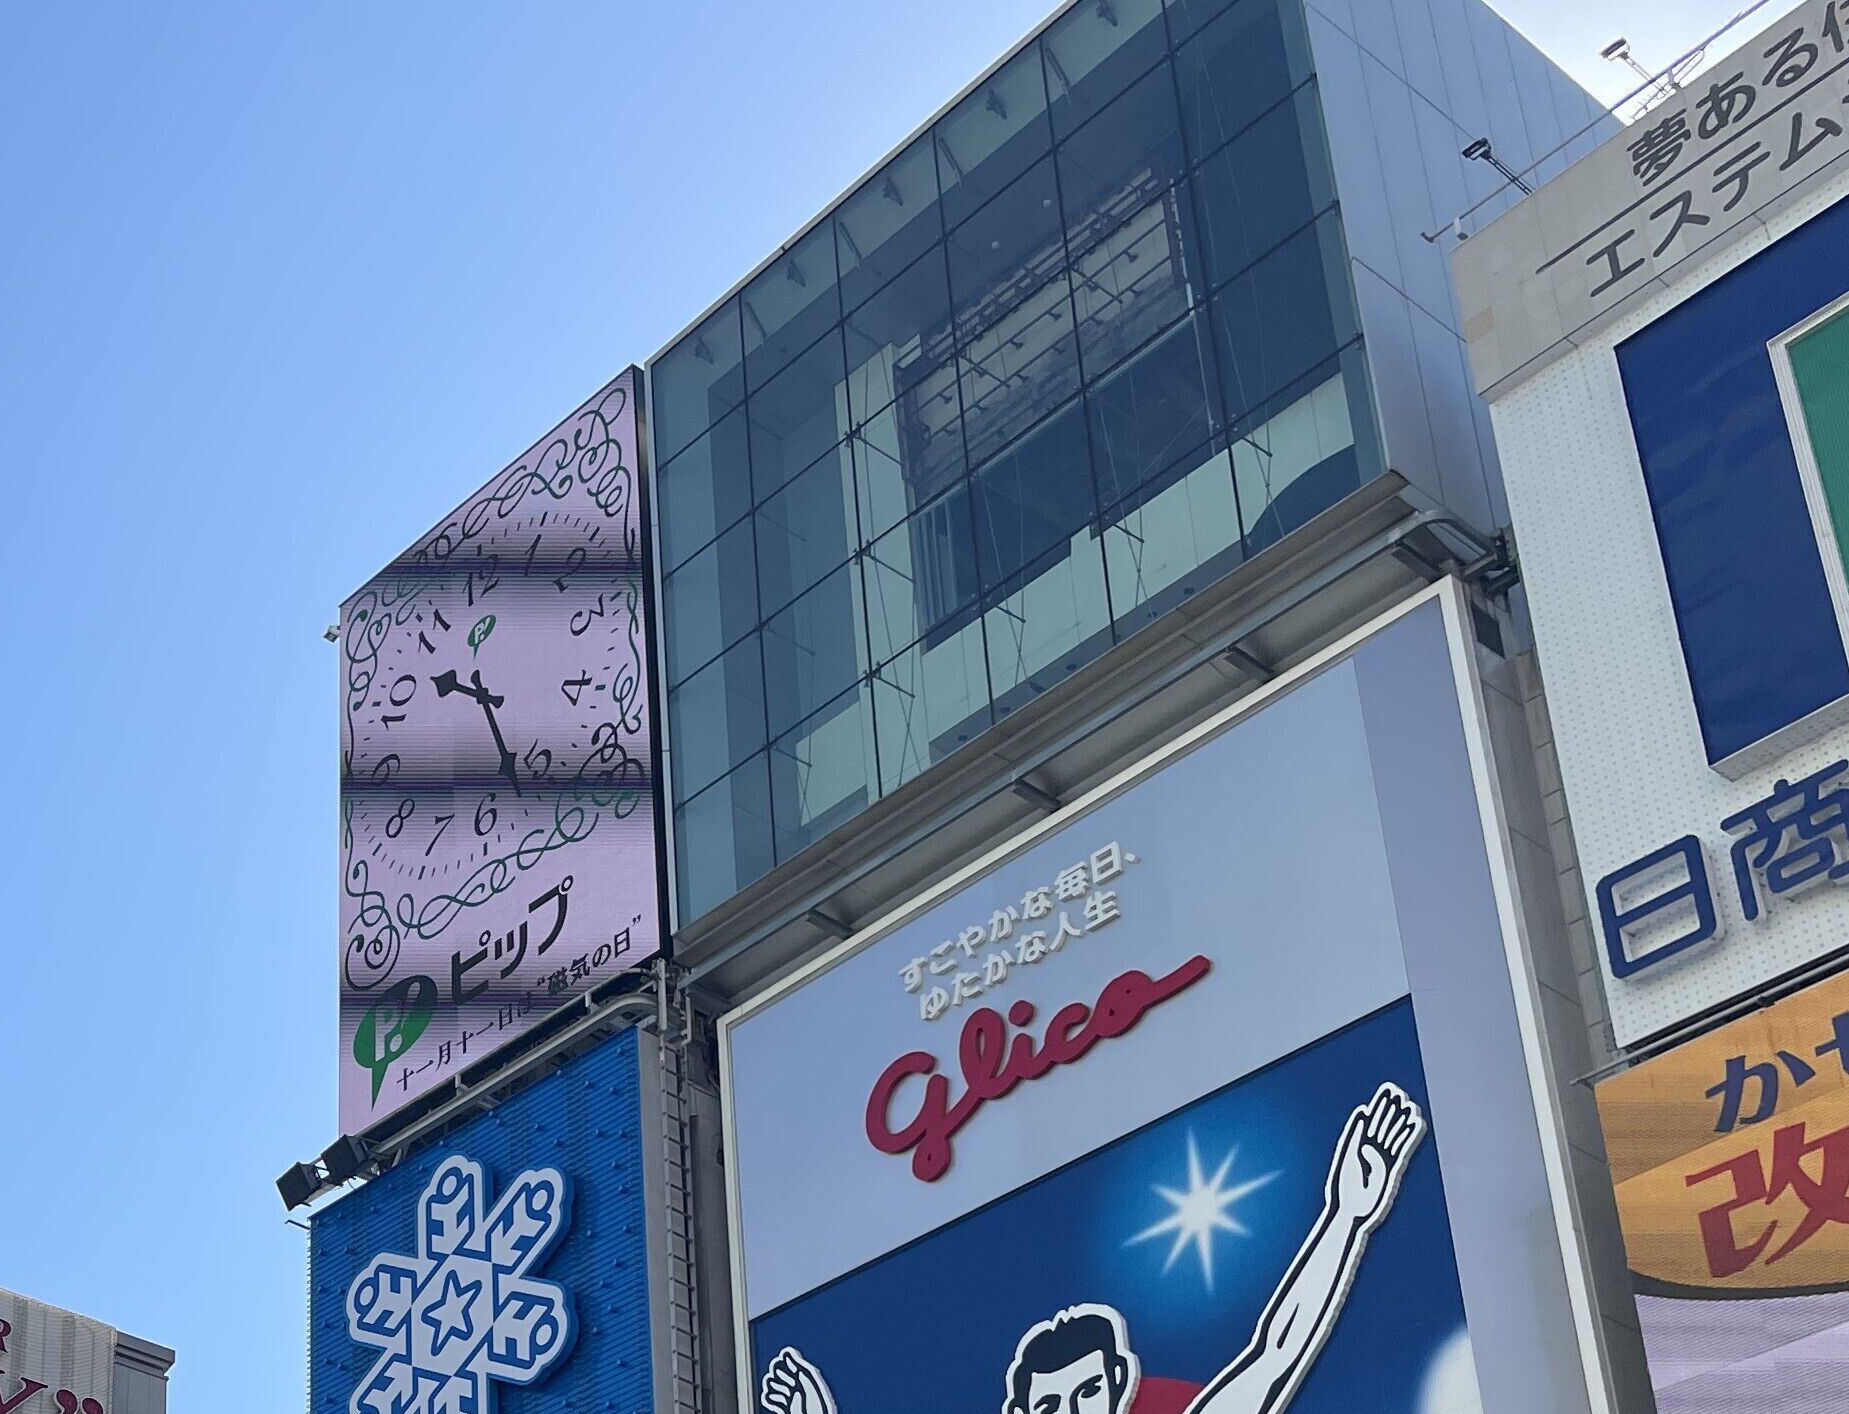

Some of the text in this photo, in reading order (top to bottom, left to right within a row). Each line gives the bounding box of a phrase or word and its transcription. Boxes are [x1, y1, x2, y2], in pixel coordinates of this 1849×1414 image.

[1587, 92, 1849, 297] エステム
[463, 553, 500, 607] 12
[418, 608, 451, 654] 11
[569, 593, 604, 636] 3
[380, 674, 416, 730] 10
[561, 670, 592, 706] 4
[524, 739, 551, 779] 5
[386, 798, 415, 839] 8
[425, 814, 455, 856] 7
[474, 792, 497, 836] 6
[451, 875, 574, 1001] ピップ
[898, 840, 1140, 993] すこやかな毎日、
[920, 890, 1122, 1023] ゆたかな人生
